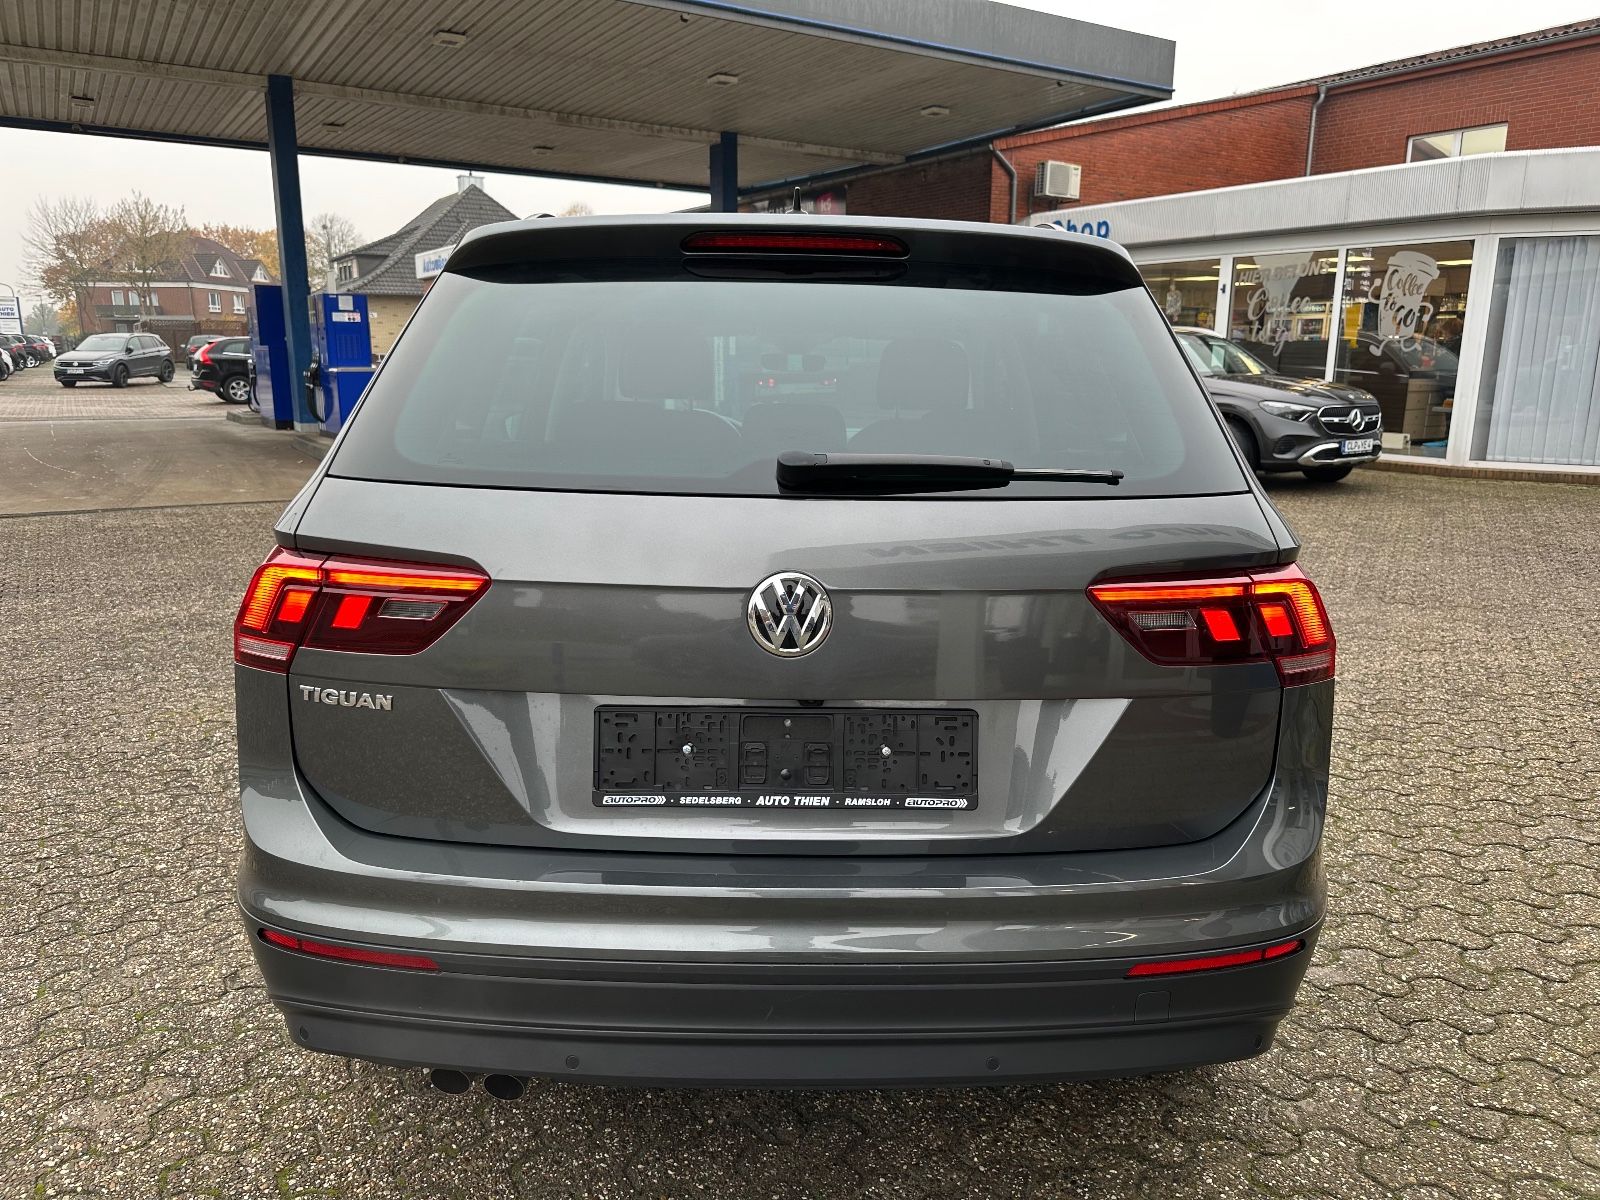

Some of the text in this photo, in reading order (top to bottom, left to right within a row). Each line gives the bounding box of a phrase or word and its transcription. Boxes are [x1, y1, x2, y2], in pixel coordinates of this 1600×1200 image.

[1298, 261, 1330, 277] UNS
[1387, 268, 1424, 297] Coffee
[1246, 287, 1311, 327] Coffee
[299, 684, 393, 711] TIGUAN
[679, 796, 742, 805] SEDELSBERG
[756, 796, 790, 806] AUTO
[793, 796, 830, 806] THIEN
[844, 798, 891, 806] RAMSLOH
